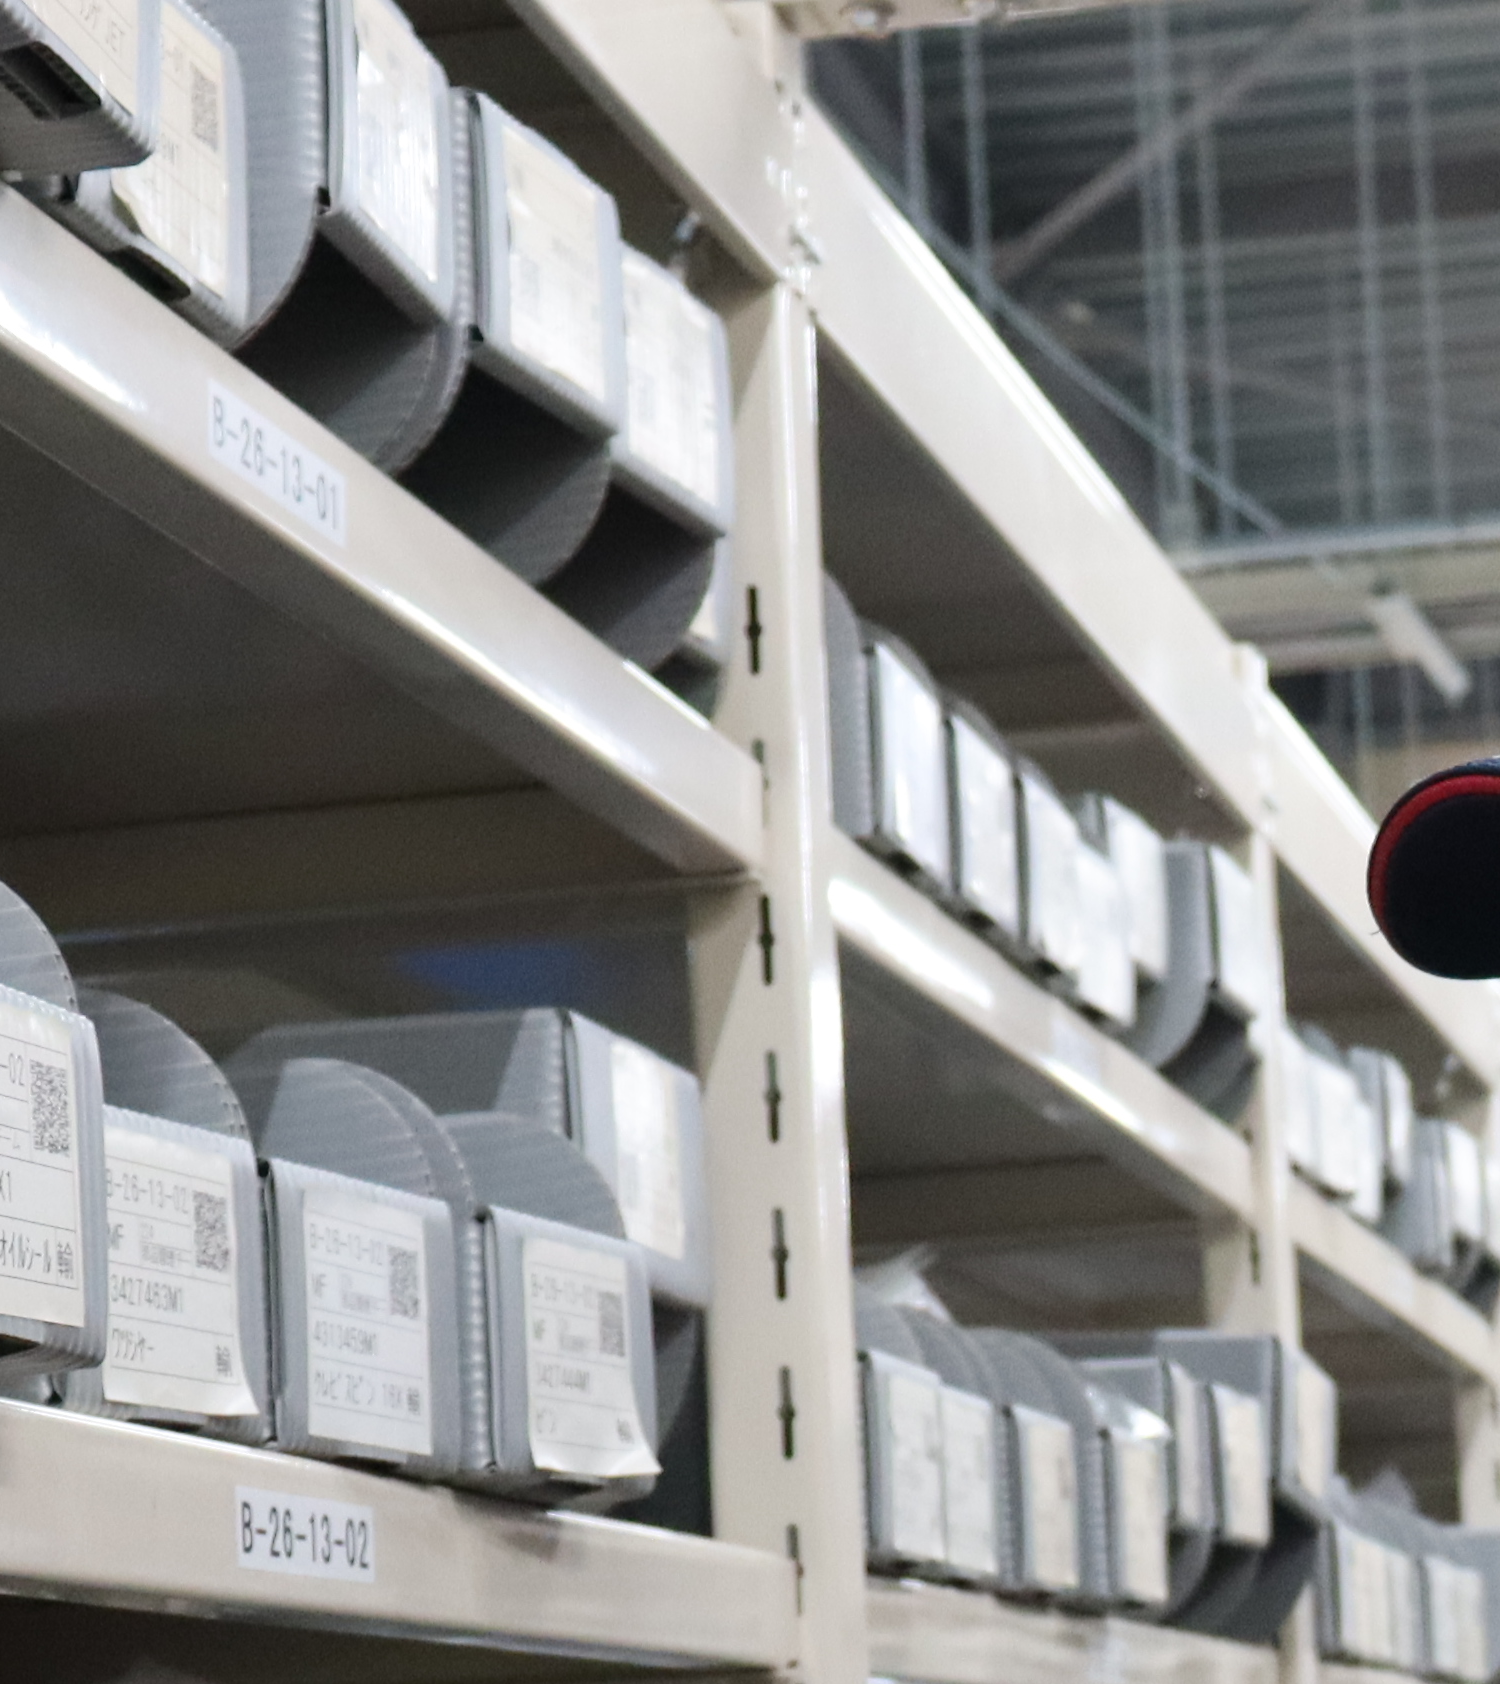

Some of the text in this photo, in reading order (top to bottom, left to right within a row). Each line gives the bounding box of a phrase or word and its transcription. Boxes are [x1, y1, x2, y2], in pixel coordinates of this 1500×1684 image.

[212, 395, 337, 530] B-26-13-01
[106, 1168, 190, 1215] B-26-13-02
[240, 1501, 370, 1570] B-26-13-02
